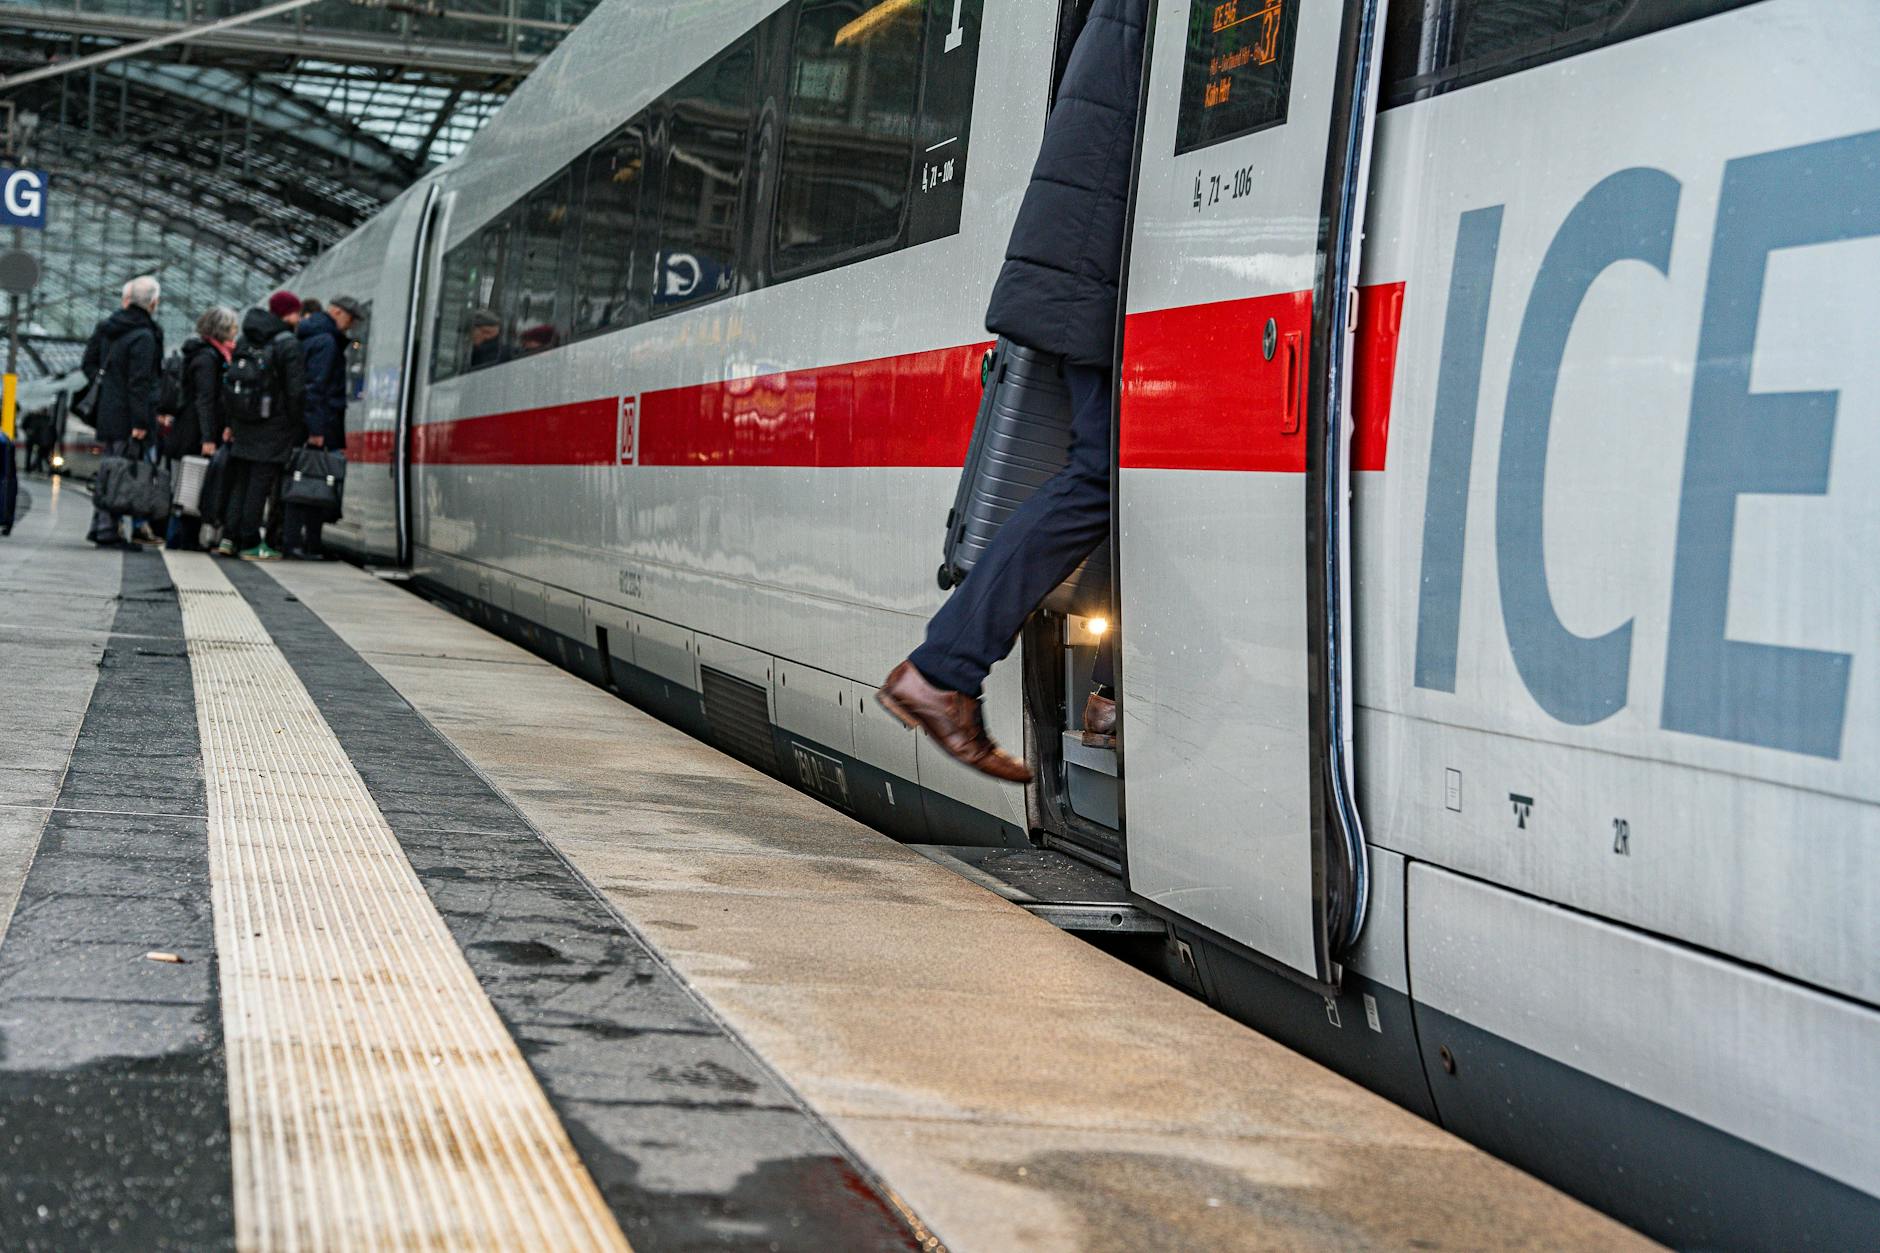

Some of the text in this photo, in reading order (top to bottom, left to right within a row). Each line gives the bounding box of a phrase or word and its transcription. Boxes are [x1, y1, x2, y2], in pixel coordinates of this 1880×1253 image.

[4, 169, 42, 217] G
[1208, 174, 1220, 206] 71
[1232, 164, 1253, 199] 106
[1415, 129, 1880, 760] ICE
